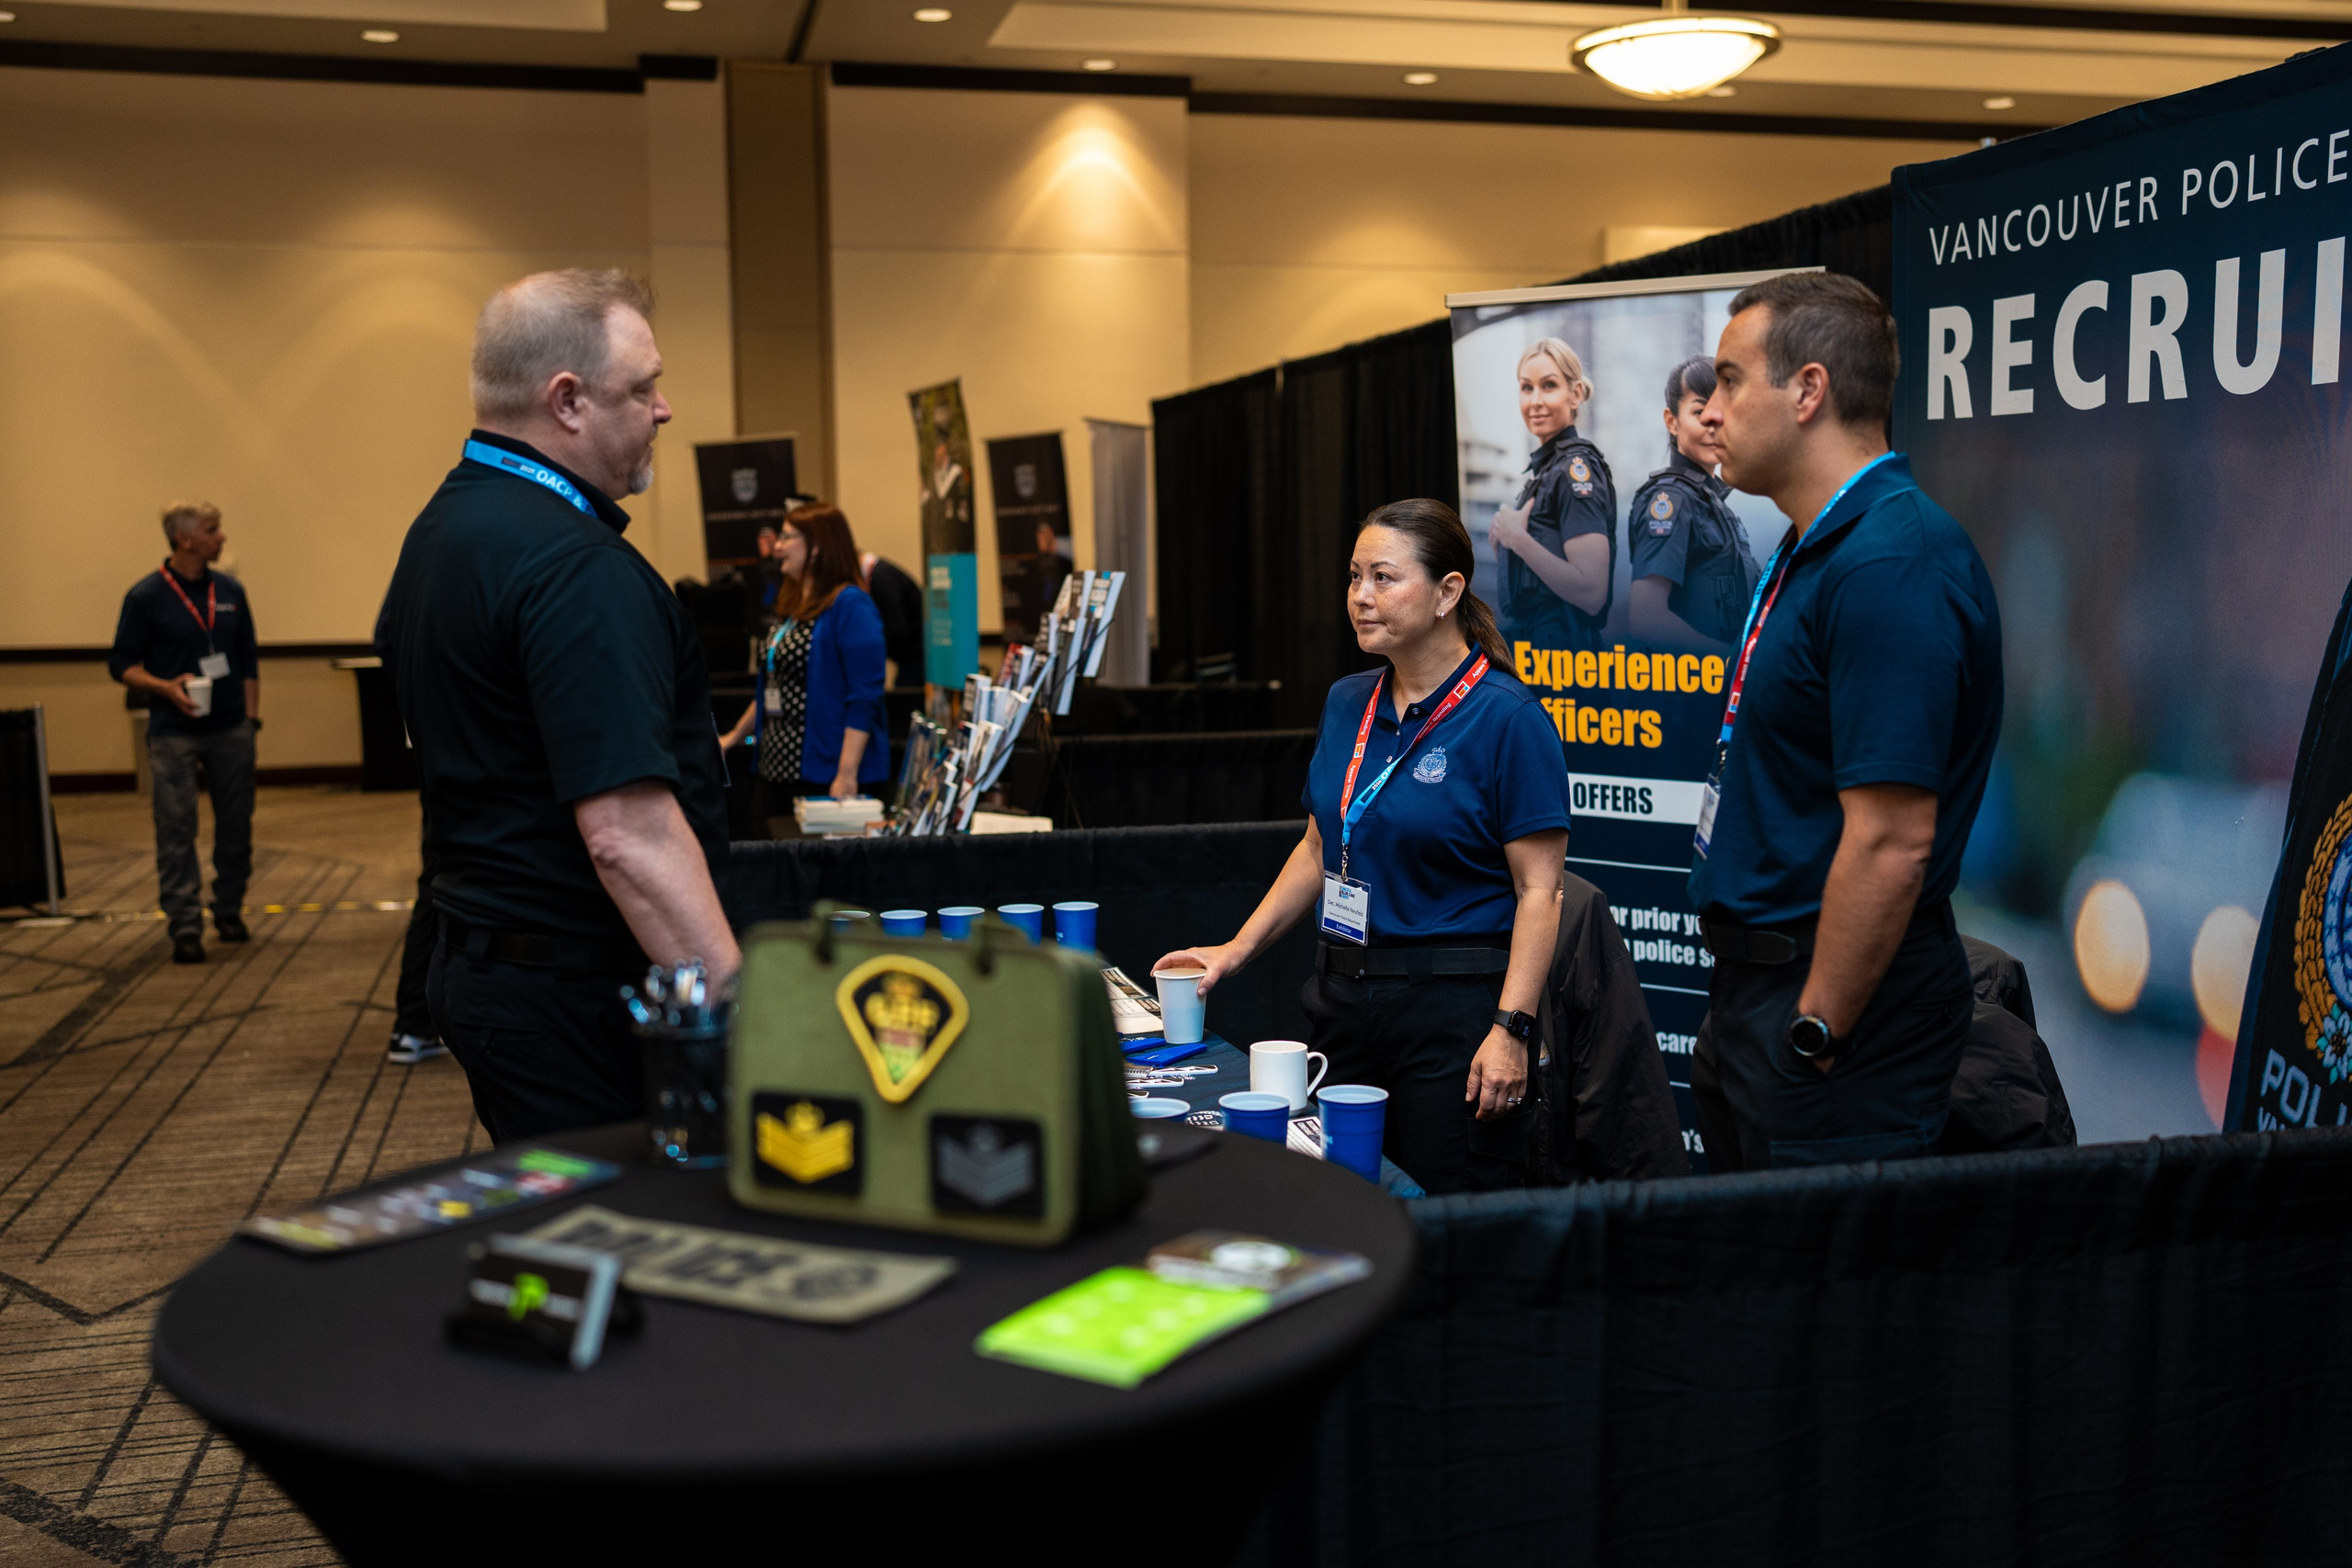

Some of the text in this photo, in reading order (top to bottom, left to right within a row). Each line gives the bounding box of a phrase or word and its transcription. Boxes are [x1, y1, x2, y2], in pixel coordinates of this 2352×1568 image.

[1929, 129, 2350, 265] VANCOUVER POLICE
[1928, 236, 2346, 421] RECRUI
[1514, 641, 1731, 694] Experience
[1572, 782, 1653, 816] OFFERS
[1631, 907, 1680, 933] prior
[1633, 939, 1696, 966] police
